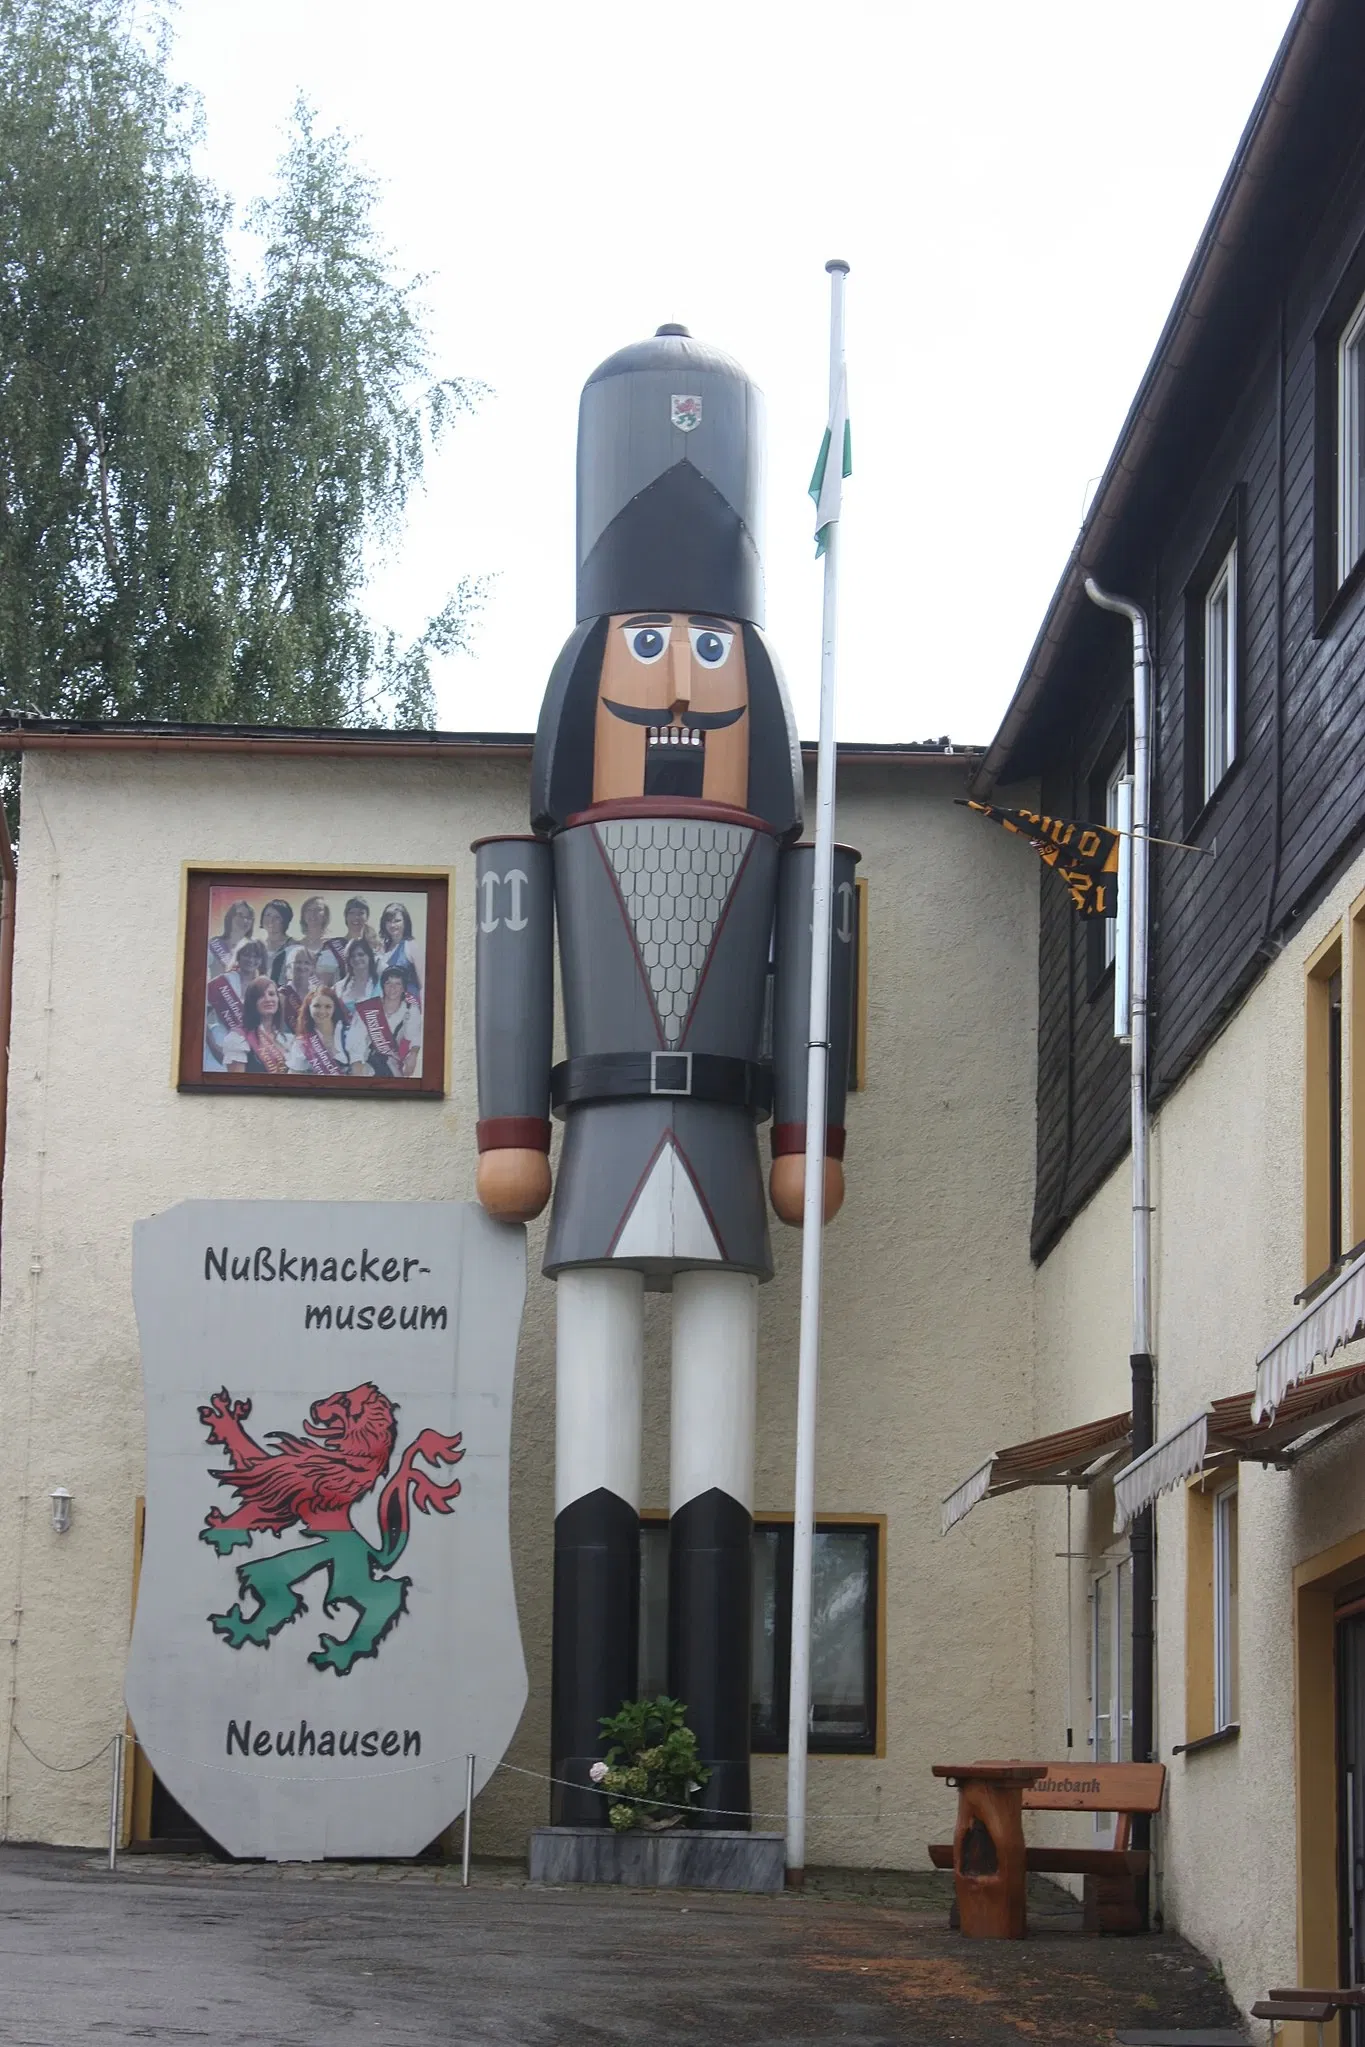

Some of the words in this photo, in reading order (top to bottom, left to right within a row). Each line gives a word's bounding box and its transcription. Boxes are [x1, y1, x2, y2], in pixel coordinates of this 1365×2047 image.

[204, 1246, 431, 1282] Nußknacker-
[304, 1304, 448, 1330] museum
[226, 1719, 421, 1757] Neuhausen
